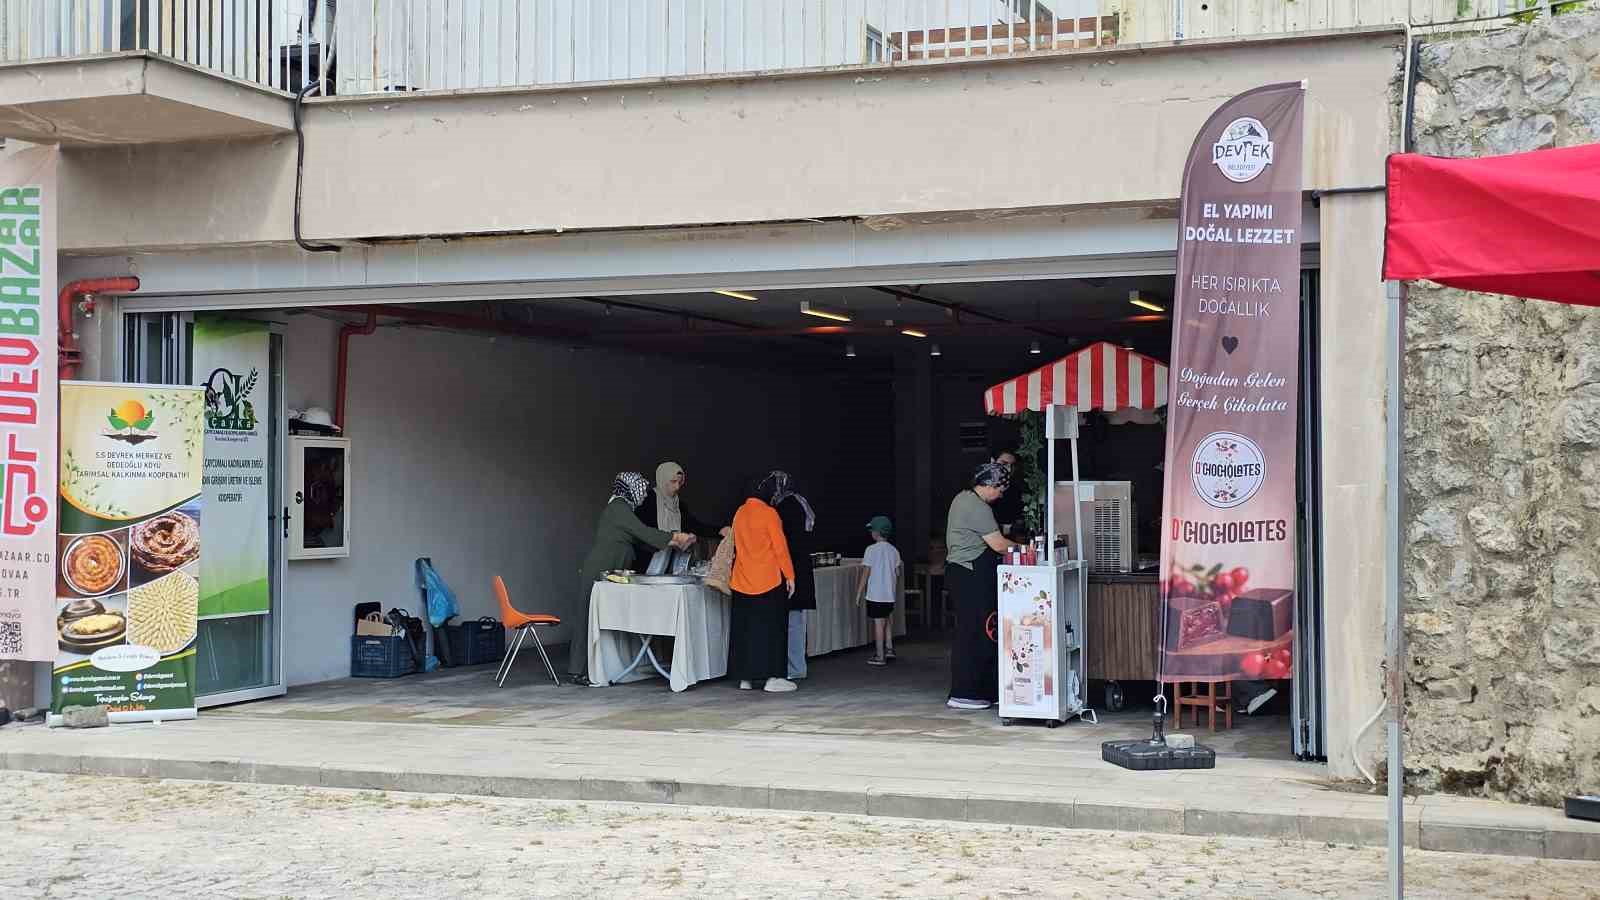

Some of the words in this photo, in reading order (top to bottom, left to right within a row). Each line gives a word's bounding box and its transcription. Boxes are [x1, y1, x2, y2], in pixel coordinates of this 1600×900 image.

[1203, 203, 1219, 218] EL
[1223, 204, 1273, 219] YAPIMI
[1185, 224, 1233, 243] DOĞAL
[1237, 228, 1295, 244] LEZZET
[1191, 274, 1218, 290] HER
[1222, 276, 1282, 293] ISIRIKTA
[1198, 297, 1271, 317] DOĞALLIK
[1180, 367, 1239, 389] Doğadan
[1243, 372, 1287, 388] Gelen
[1177, 392, 1218, 412] Gerçek
[1223, 396, 1288, 414] Çikolata
[107, 451, 134, 459] DEVREK
[135, 452, 163, 460] MERKEZ
[76, 470, 110, 478] TARIMSAL
[111, 470, 146, 479] KALKINMA
